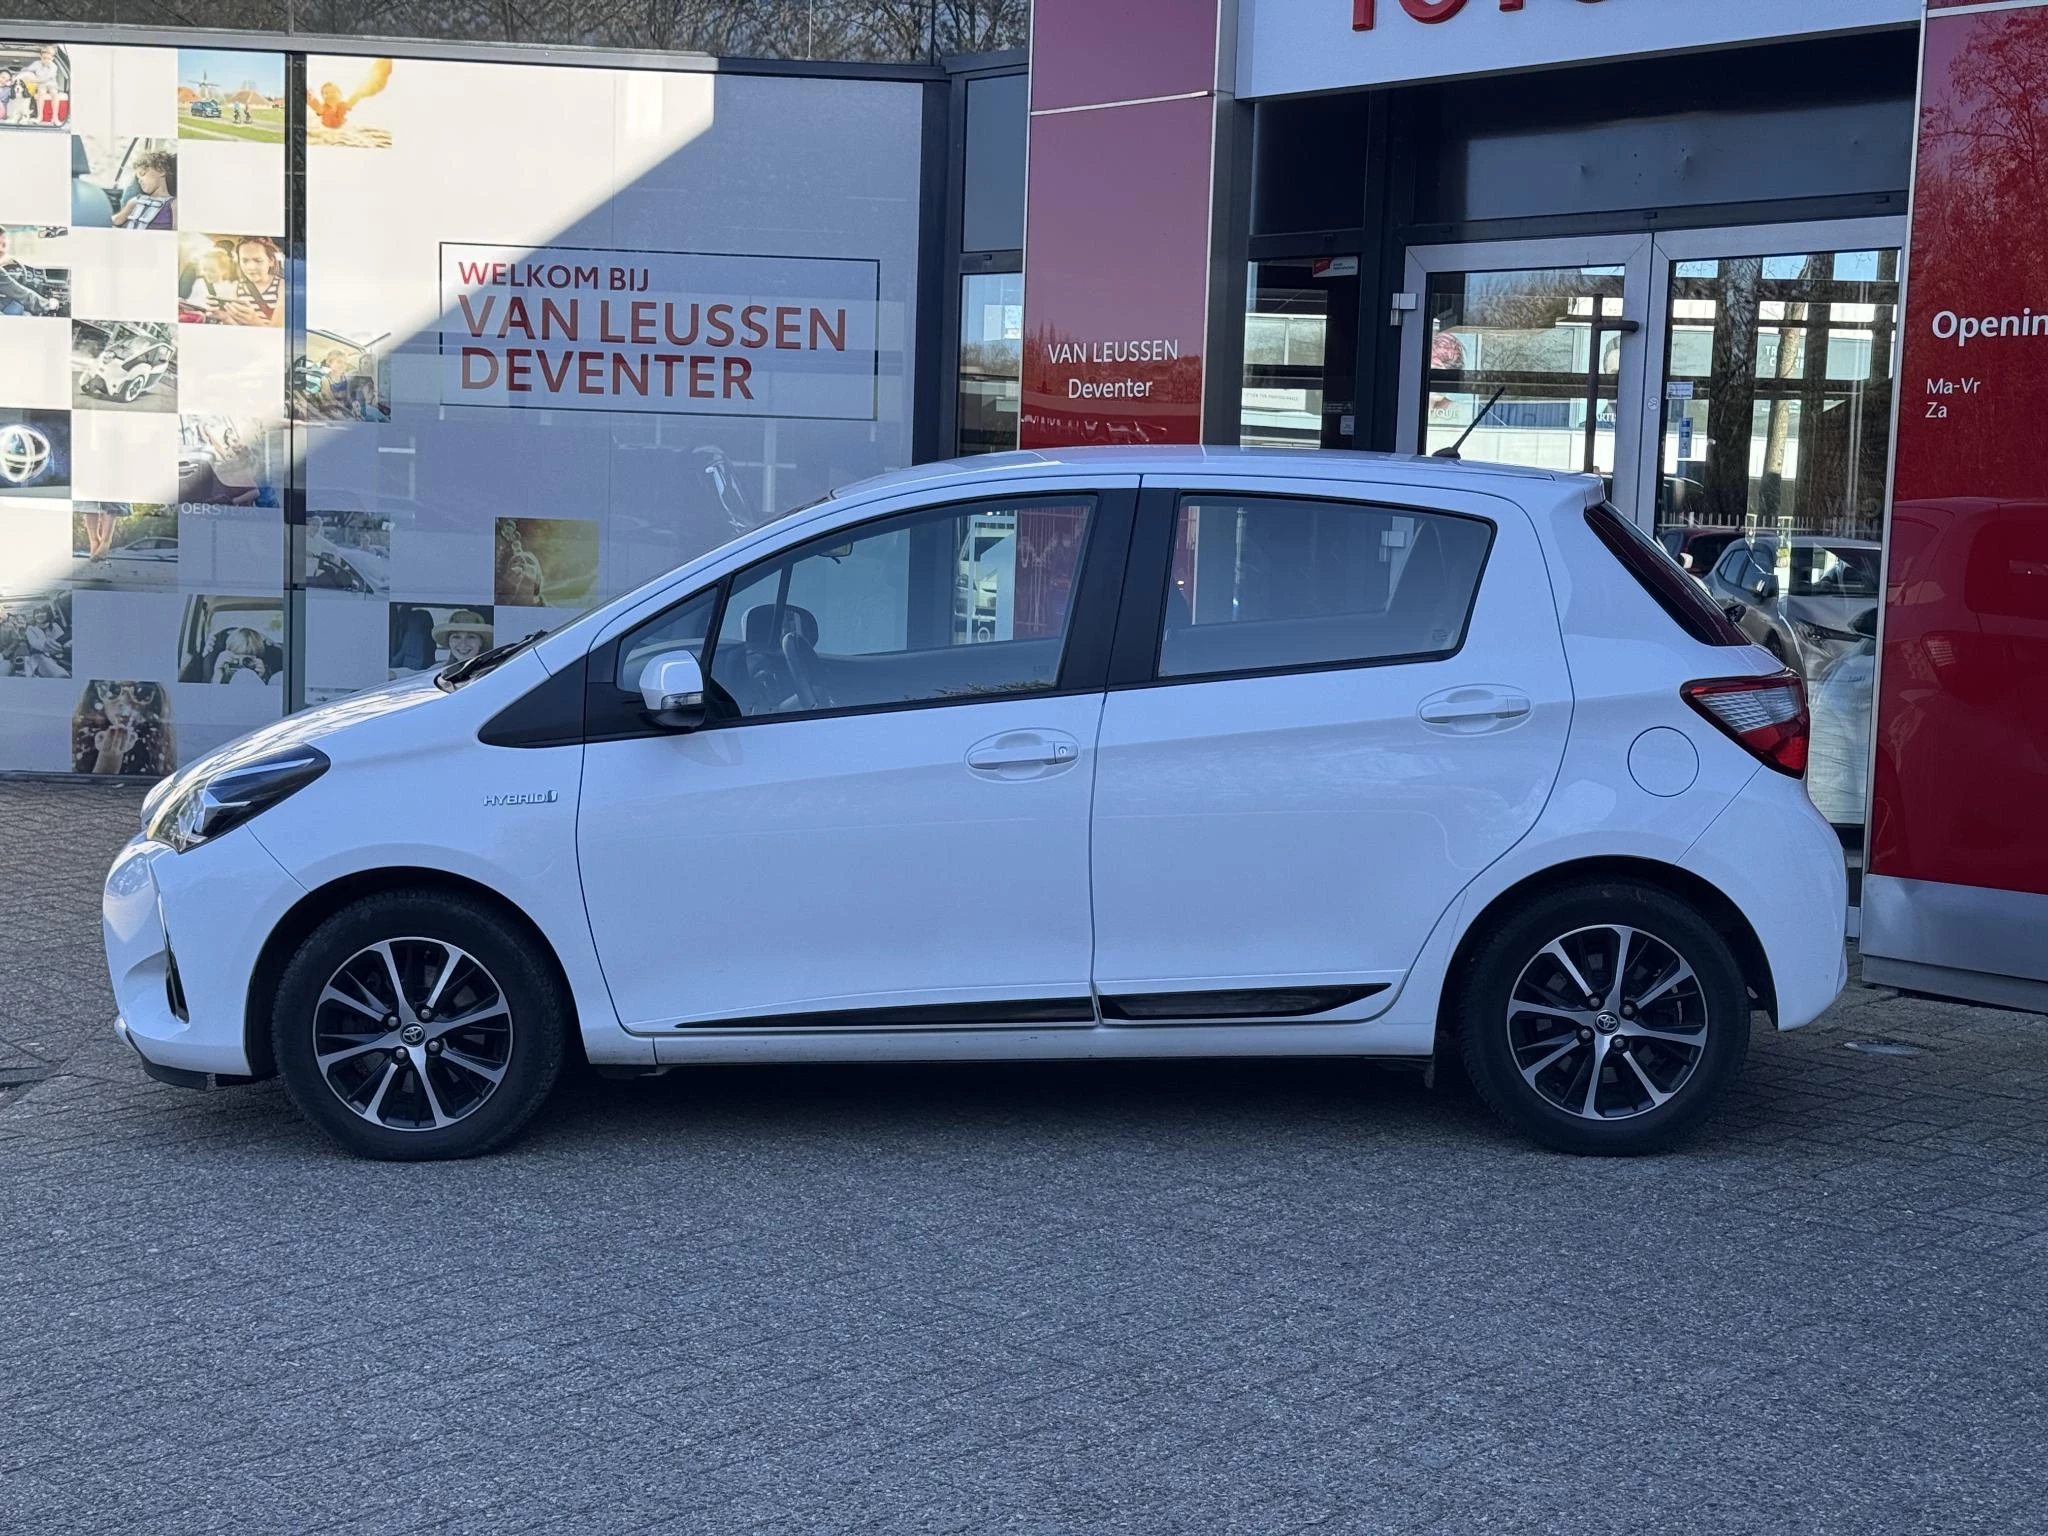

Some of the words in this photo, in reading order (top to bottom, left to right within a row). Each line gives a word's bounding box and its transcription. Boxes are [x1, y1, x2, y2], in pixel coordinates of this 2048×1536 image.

[458, 261, 598, 290] WELKOM
[609, 267, 649, 292] BIJ
[458, 294, 579, 341] VAN
[600, 300, 846, 351] LEUSSEN
[1048, 342, 1087, 364] VAN
[1093, 339, 1178, 363] LEUSSEN
[461, 346, 755, 400] DEVENTER
[1068, 378, 1153, 399] Deventer
[1926, 377, 1981, 394] Ma-Vr
[1925, 402, 1948, 418] Za
[483, 793, 546, 806] HYBRID
